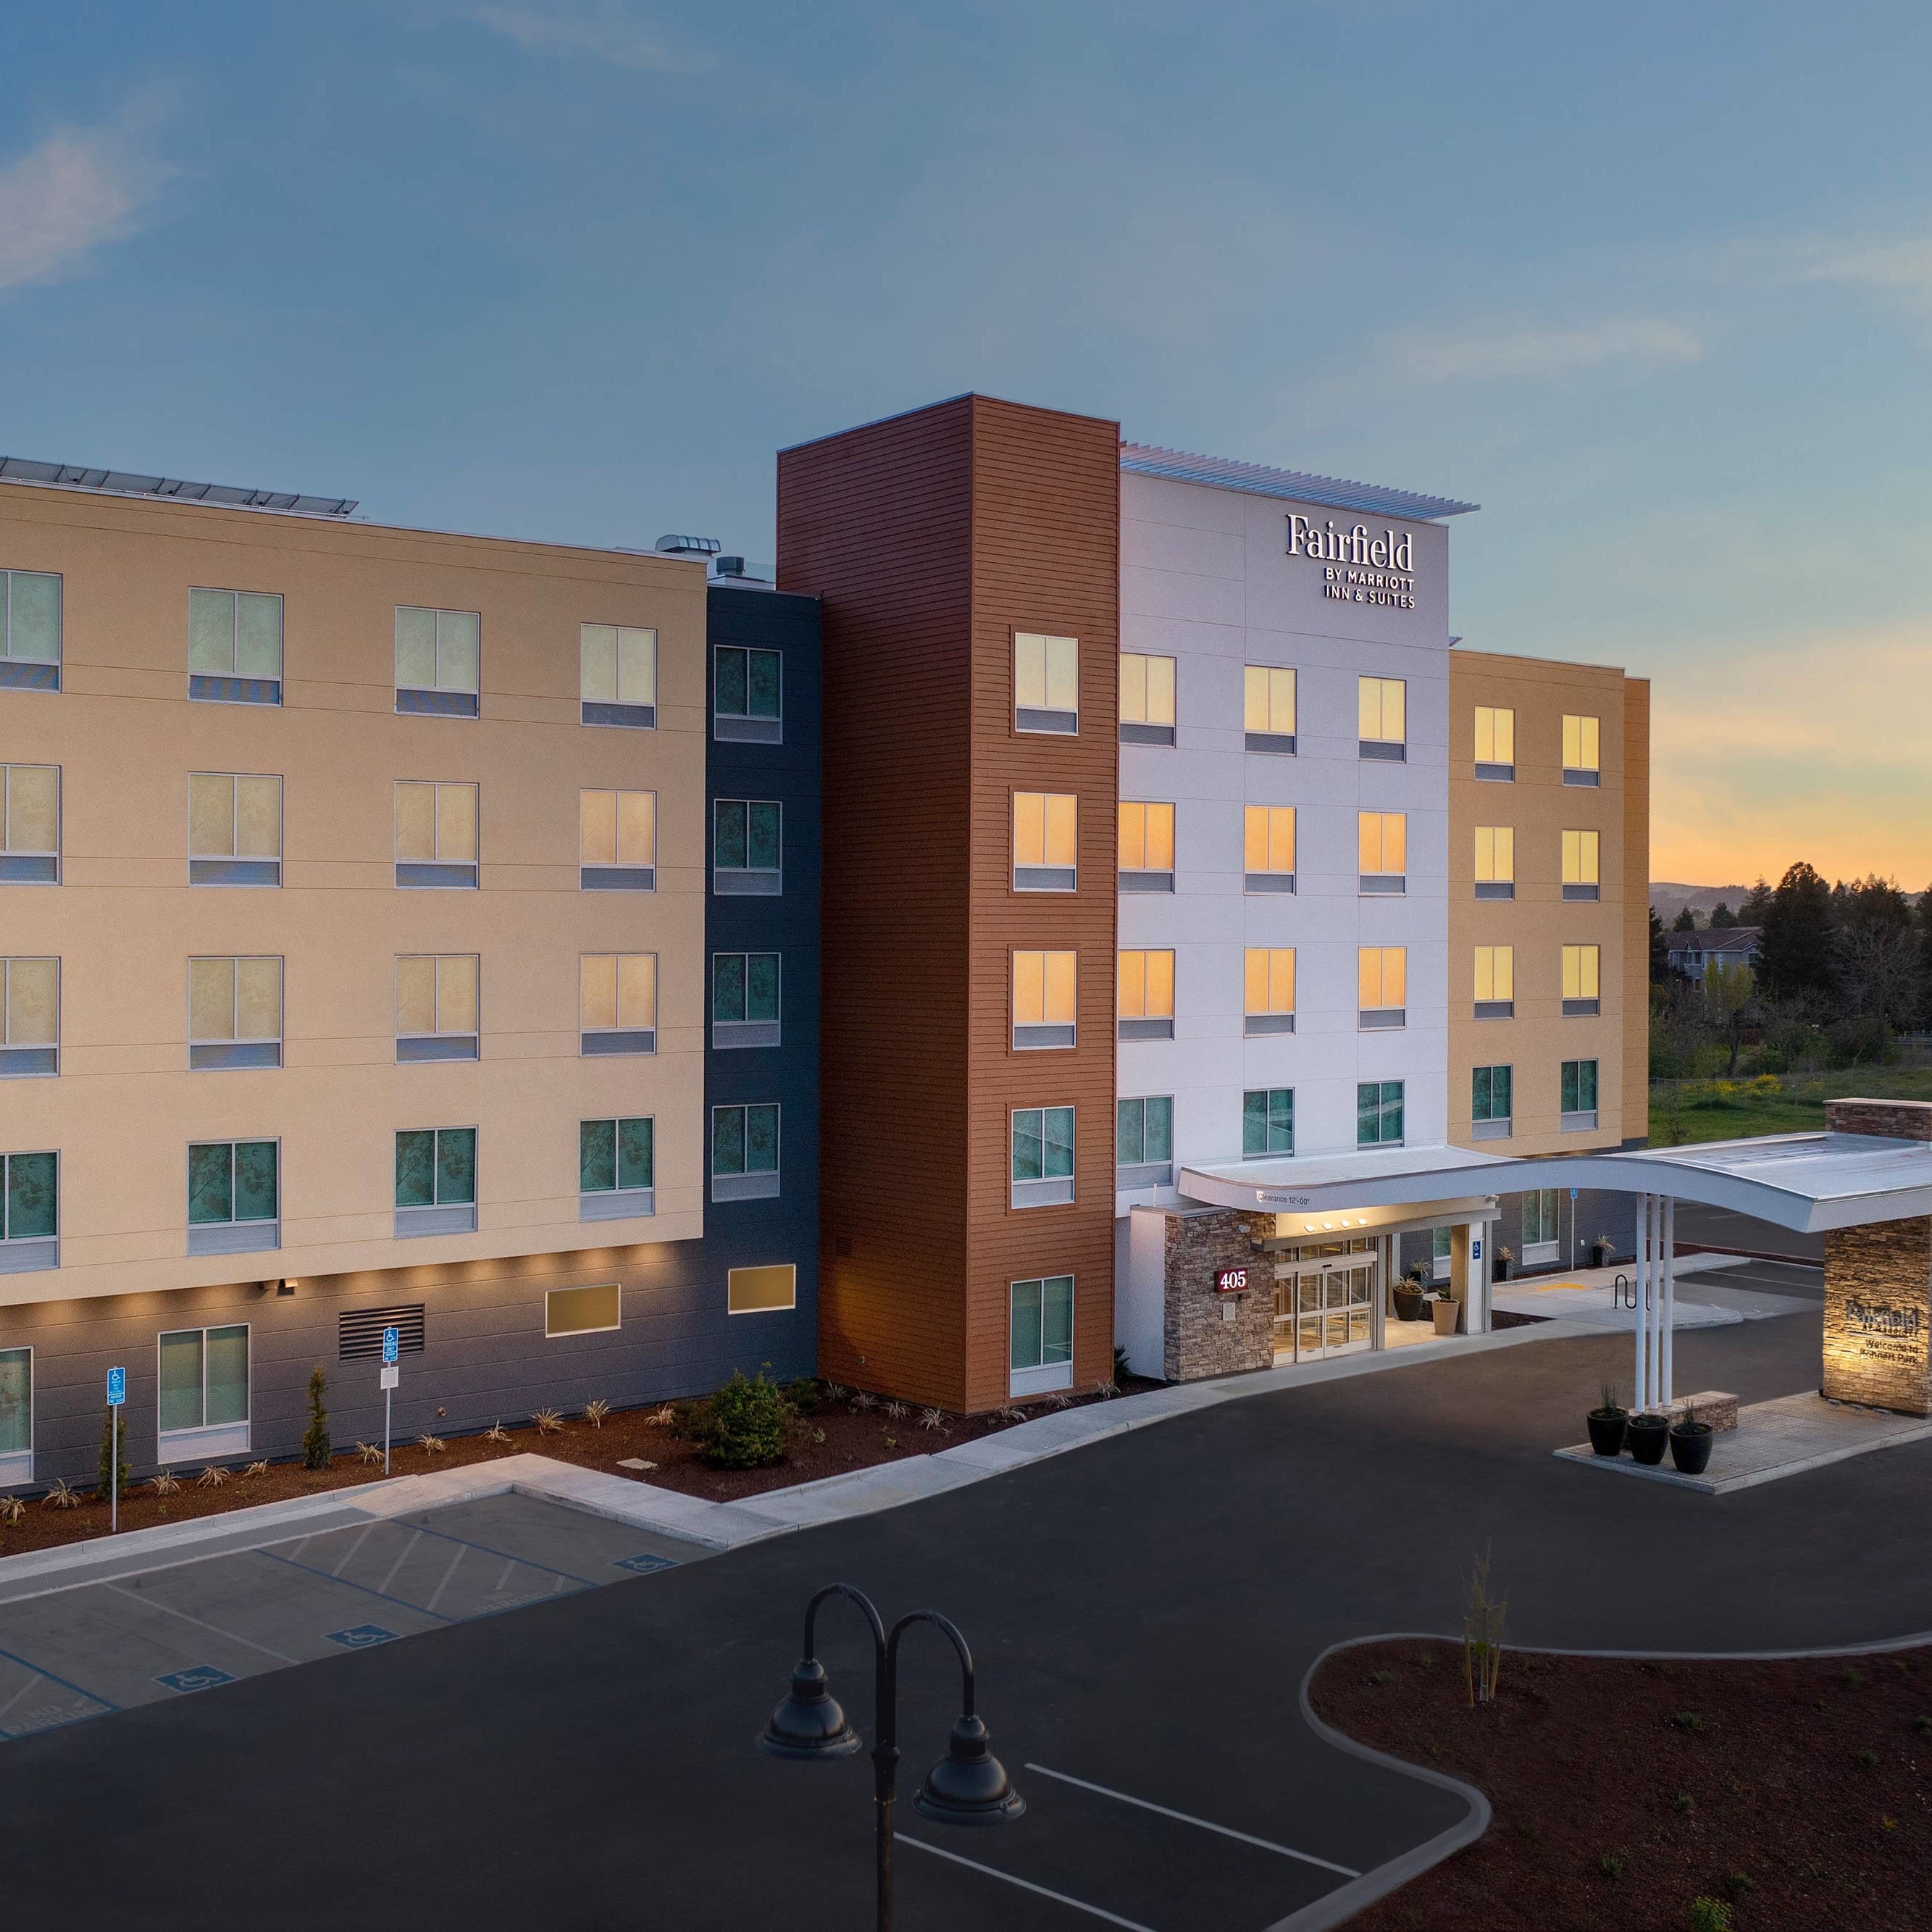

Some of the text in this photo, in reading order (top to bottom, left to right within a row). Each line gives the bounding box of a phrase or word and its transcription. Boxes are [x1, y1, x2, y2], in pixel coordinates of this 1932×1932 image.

[1287, 514, 1414, 572] Fairfield
[1326, 567, 1415, 592] BY MARRIOTT
[1326, 585, 1415, 609] INN & SUITES
[1258, 1193, 1287, 1203] Clearance
[1220, 1271, 1246, 1289] 405
[1847, 1303, 1918, 1331] Fairfield
